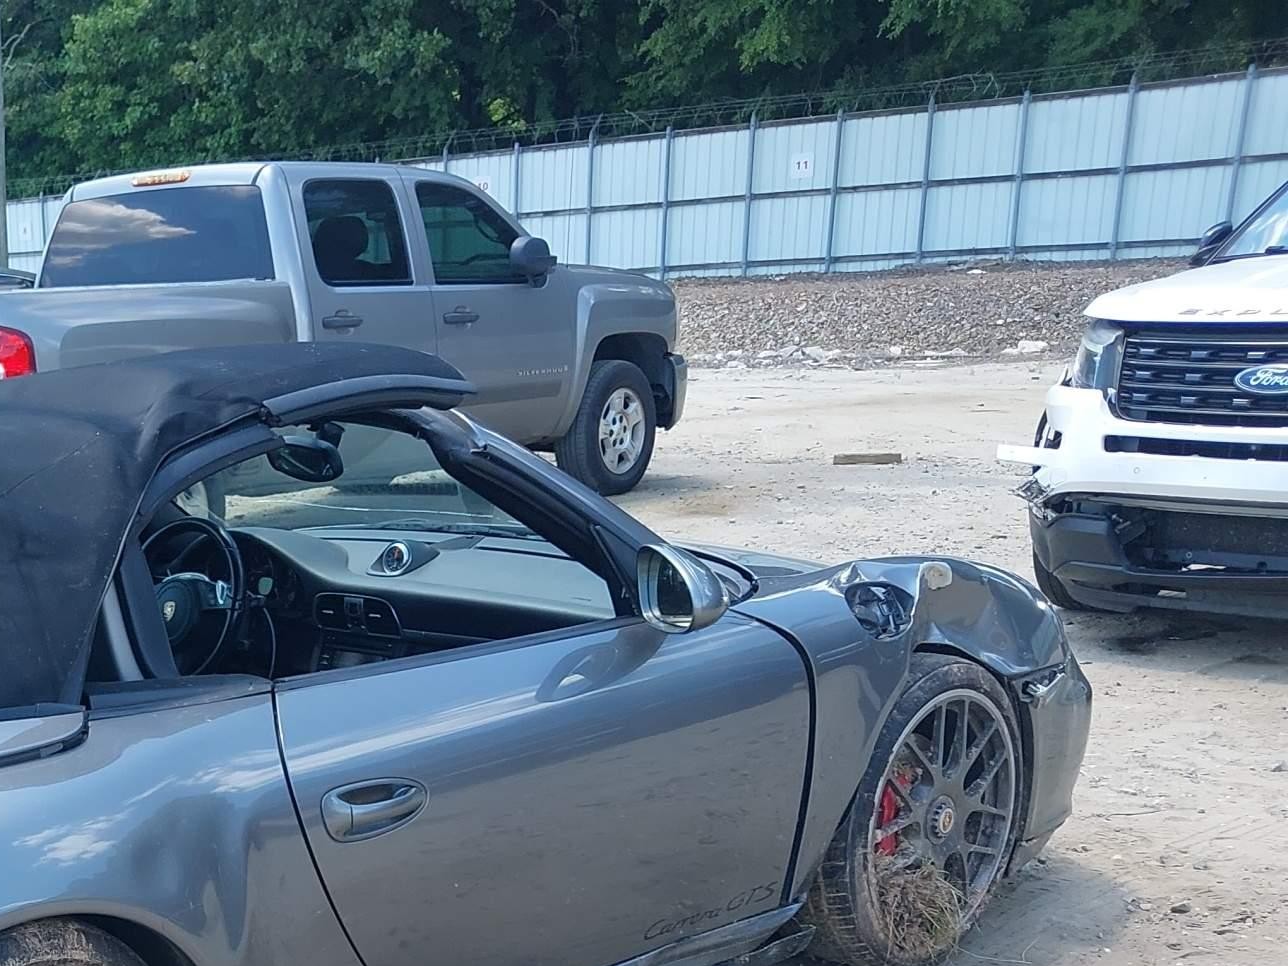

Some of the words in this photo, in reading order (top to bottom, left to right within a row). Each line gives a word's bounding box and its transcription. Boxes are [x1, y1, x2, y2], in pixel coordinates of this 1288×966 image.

[796, 161, 808, 170] 11
[644, 907, 723, 940] Carrera
[726, 881, 778, 911] GTS
